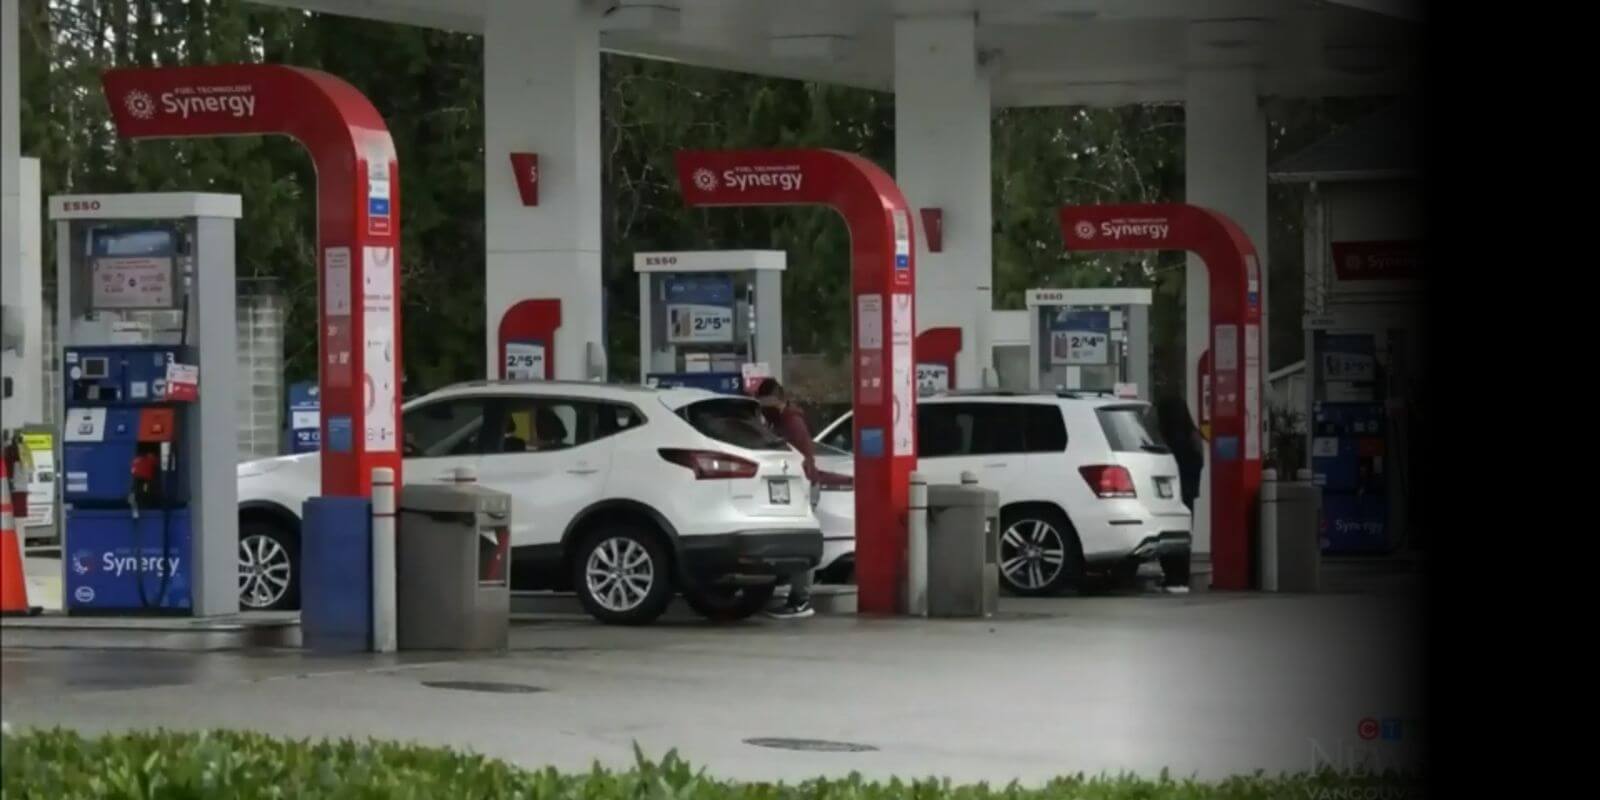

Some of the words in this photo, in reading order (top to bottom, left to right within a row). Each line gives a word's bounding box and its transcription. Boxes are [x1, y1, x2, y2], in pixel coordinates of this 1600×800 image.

[161, 92, 255, 119] Synergy
[723, 170, 802, 192] Synergy
[63, 201, 100, 211] ESSO
[1101, 222, 1168, 240] Synergy
[646, 257, 677, 265] ESSO
[102, 552, 180, 577] Synergy
